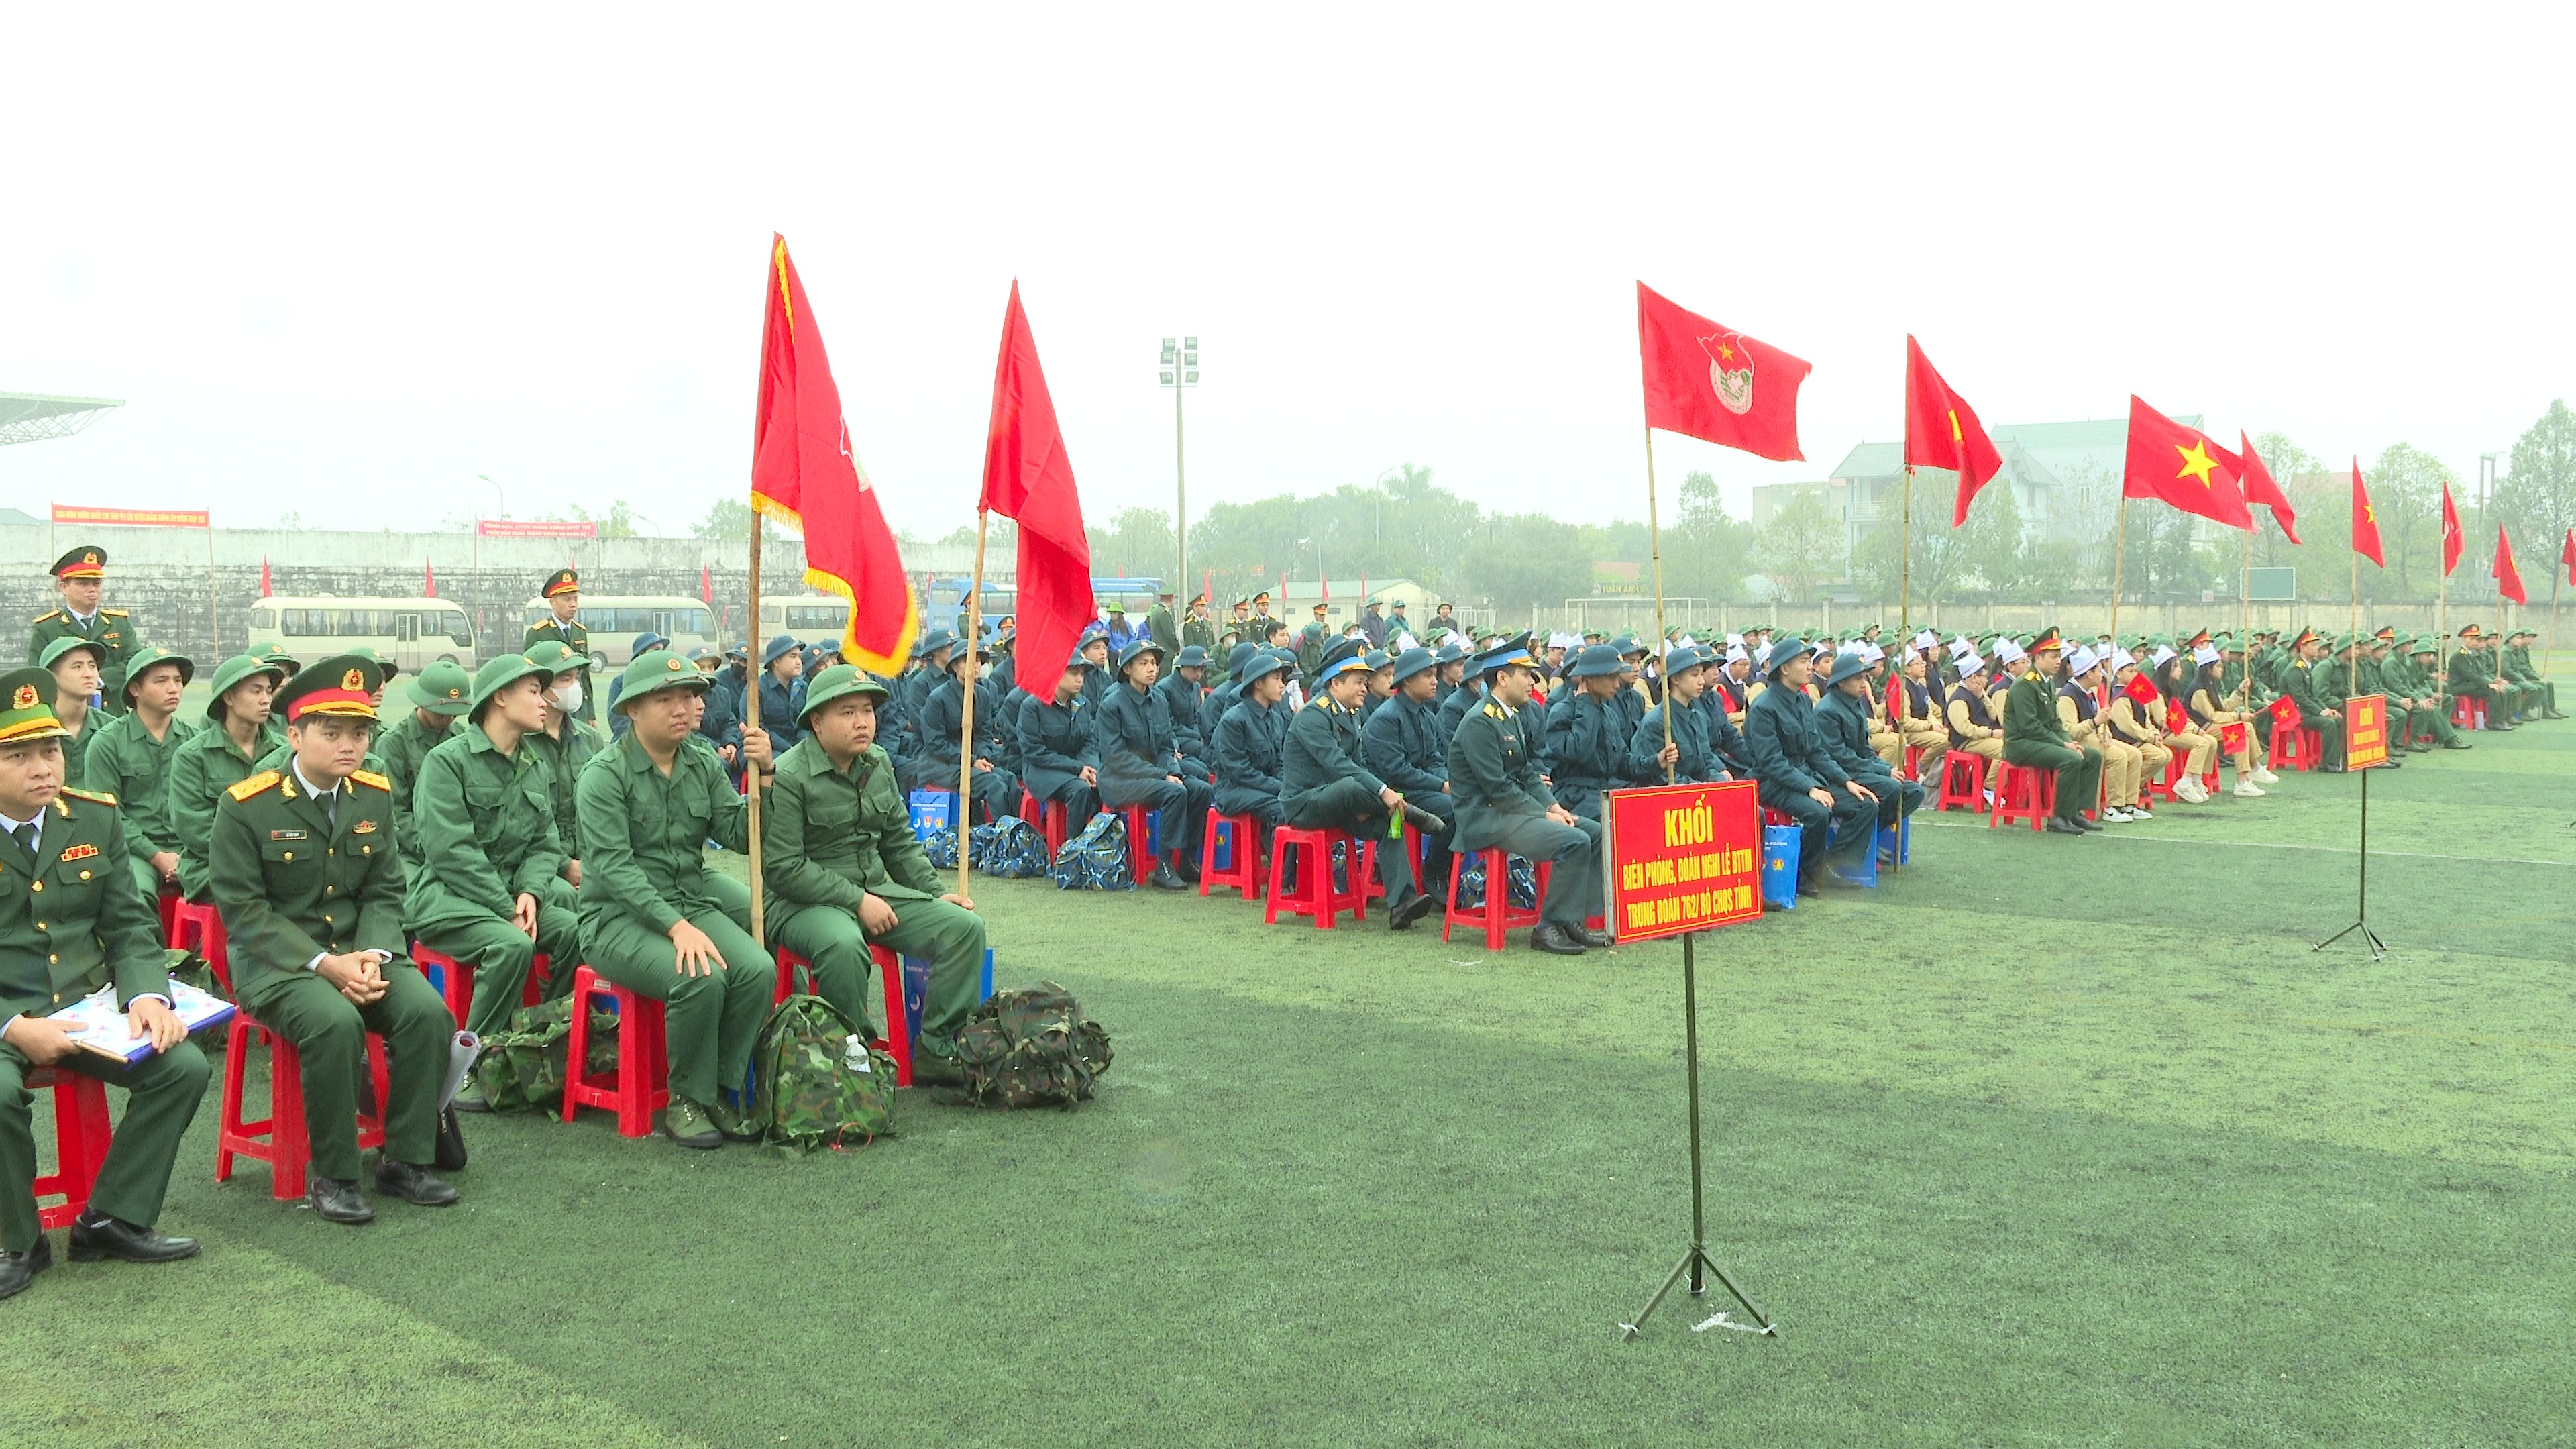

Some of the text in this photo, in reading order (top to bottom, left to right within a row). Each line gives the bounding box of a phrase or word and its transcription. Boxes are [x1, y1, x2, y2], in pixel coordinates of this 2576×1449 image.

[1664, 794, 1713, 847] KHỐI
[1623, 858, 1644, 891] BIÊN
[1646, 854, 1677, 887] PHÒNG,
[1701, 853, 1721, 879] NGHI
[1732, 848, 1752, 875] BTTM
[1627, 900, 1656, 930] TRUNG
[1681, 893, 1699, 920] 762/
[1700, 886, 1711, 921] BỘ
[1713, 888, 1733, 915] CHQS
